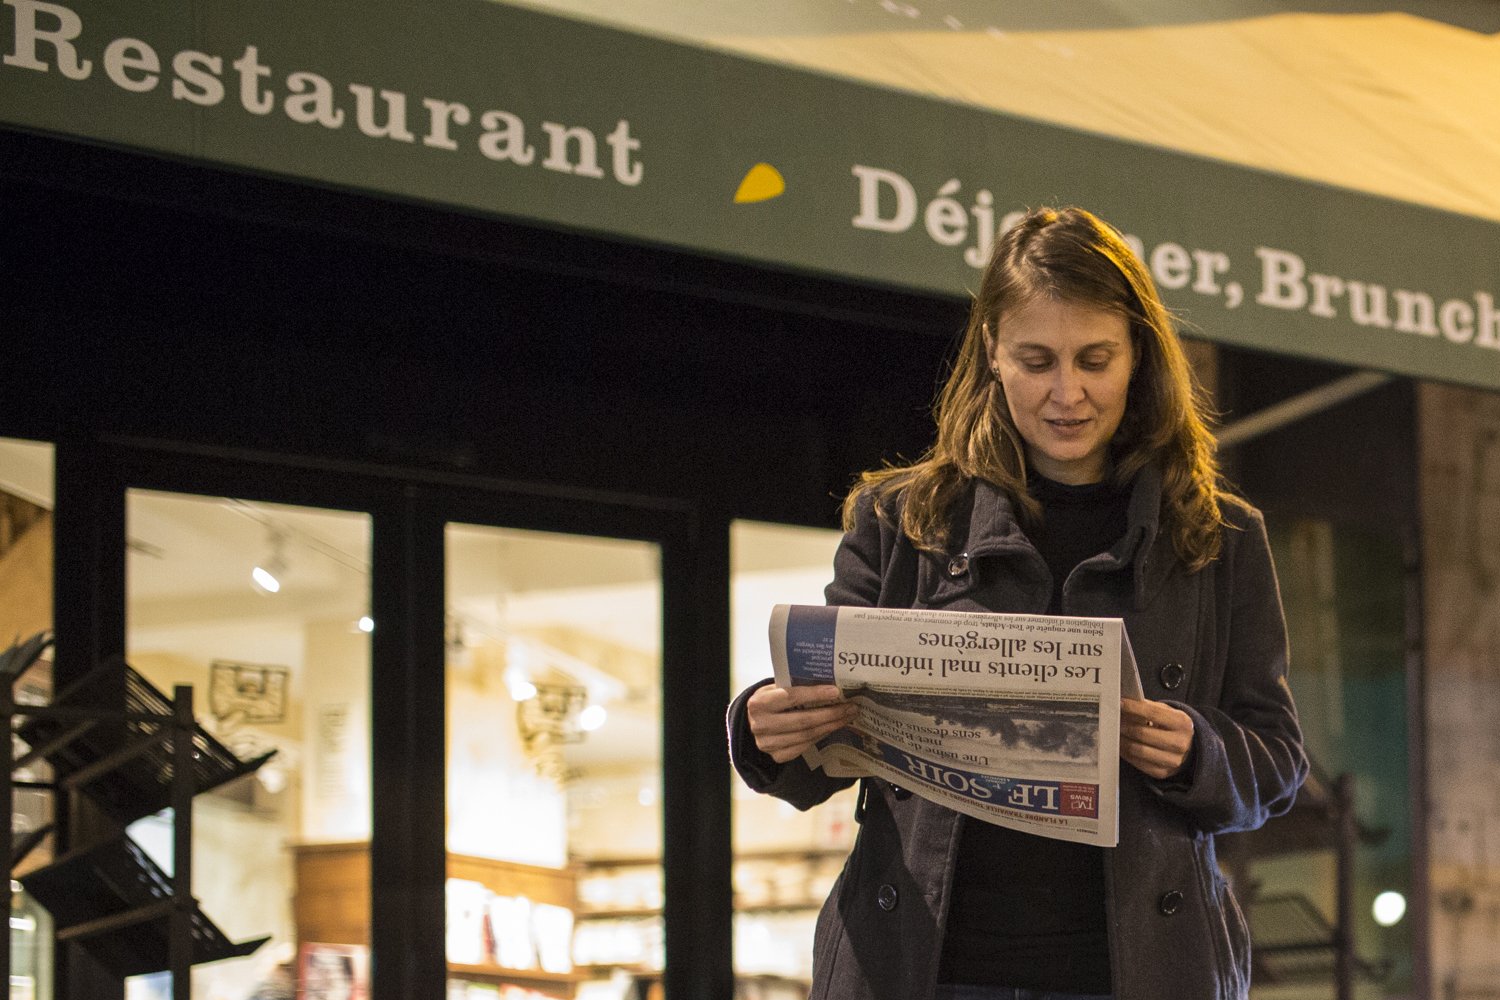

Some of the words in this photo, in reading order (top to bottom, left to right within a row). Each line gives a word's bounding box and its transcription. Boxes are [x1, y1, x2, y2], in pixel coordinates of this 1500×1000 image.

[3, 0, 644, 187] Restaurant
[851, 165, 1243, 308] Déjer,
[963, 619, 978, 627] trop
[1025, 624, 1035, 632] de
[1036, 625, 1066, 633] enquête
[1082, 628, 1104, 636] Selon
[917, 631, 1027, 660] allergènes
[1033, 640, 1062, 661] les
[1067, 643, 1103, 658] sur
[838, 651, 934, 677] informés
[940, 658, 981, 678] mal
[987, 661, 1058, 683] clients
[1064, 665, 1102, 684] Les
[906, 723, 948, 739] dessus
[952, 729, 981, 740] sens
[917, 736, 942, 747] met
[925, 747, 959, 761] usine
[962, 754, 989, 766] Une
[902, 754, 992, 799] SOIR
[1008, 784, 1058, 810] LE
[1070, 794, 1092, 803] News
[1025, 813, 1057, 825] FLANDRE
